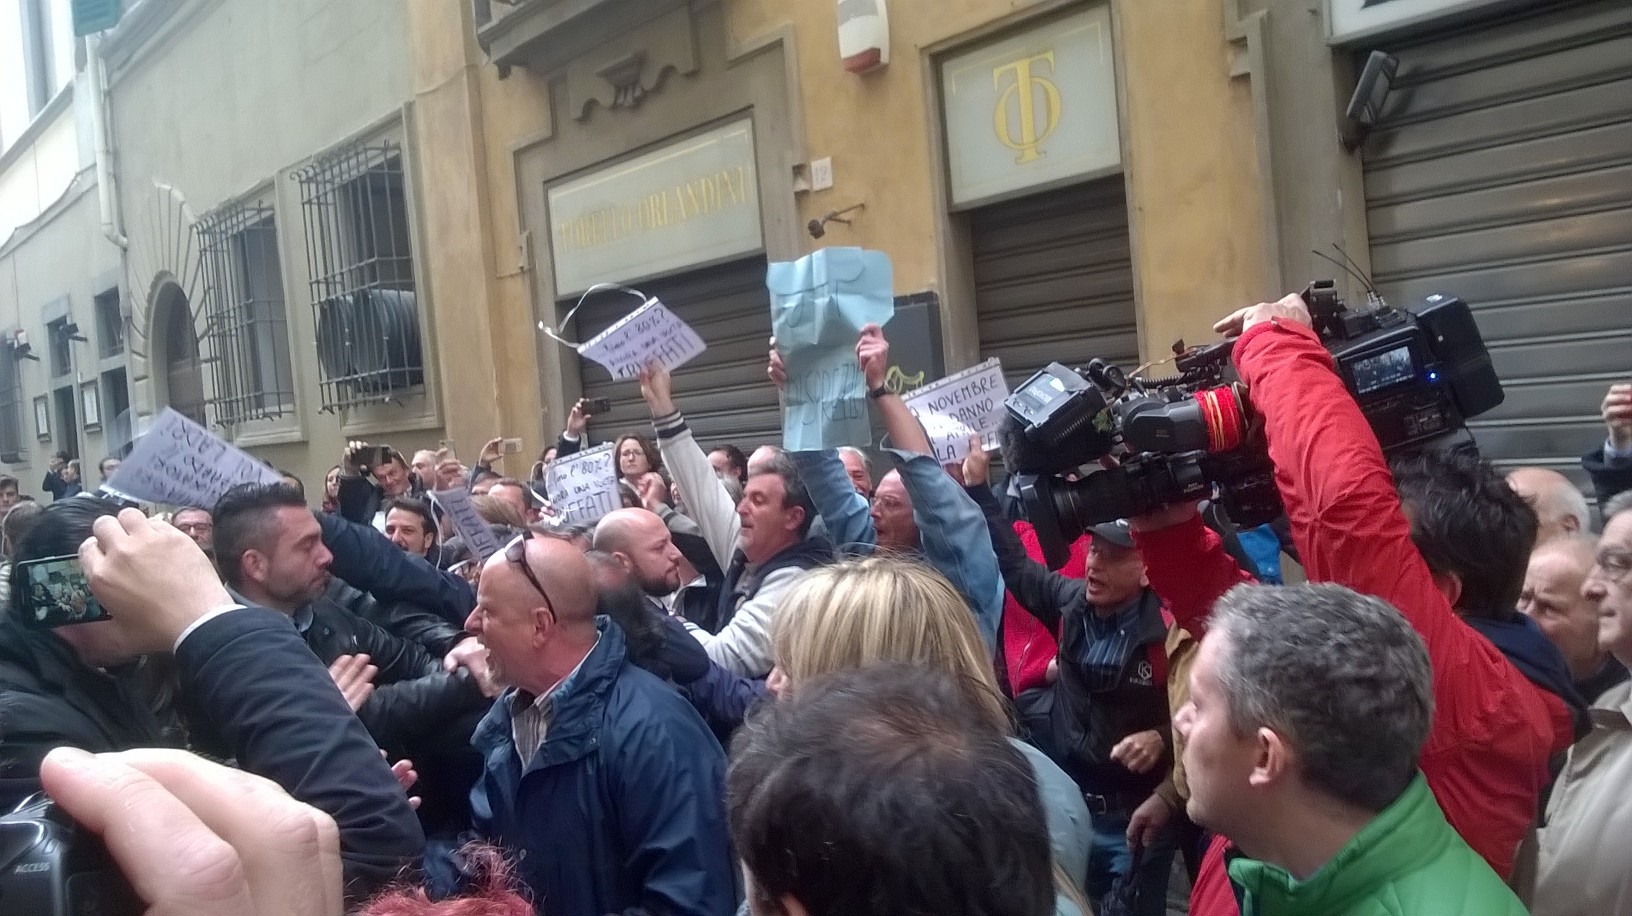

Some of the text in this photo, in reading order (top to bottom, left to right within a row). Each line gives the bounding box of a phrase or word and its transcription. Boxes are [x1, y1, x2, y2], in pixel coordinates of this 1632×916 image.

[928, 374, 998, 415] NOVEMBRE
[949, 397, 994, 423] DANNO
[937, 444, 957, 460] LA
[14, 862, 50, 874] ACCESS
